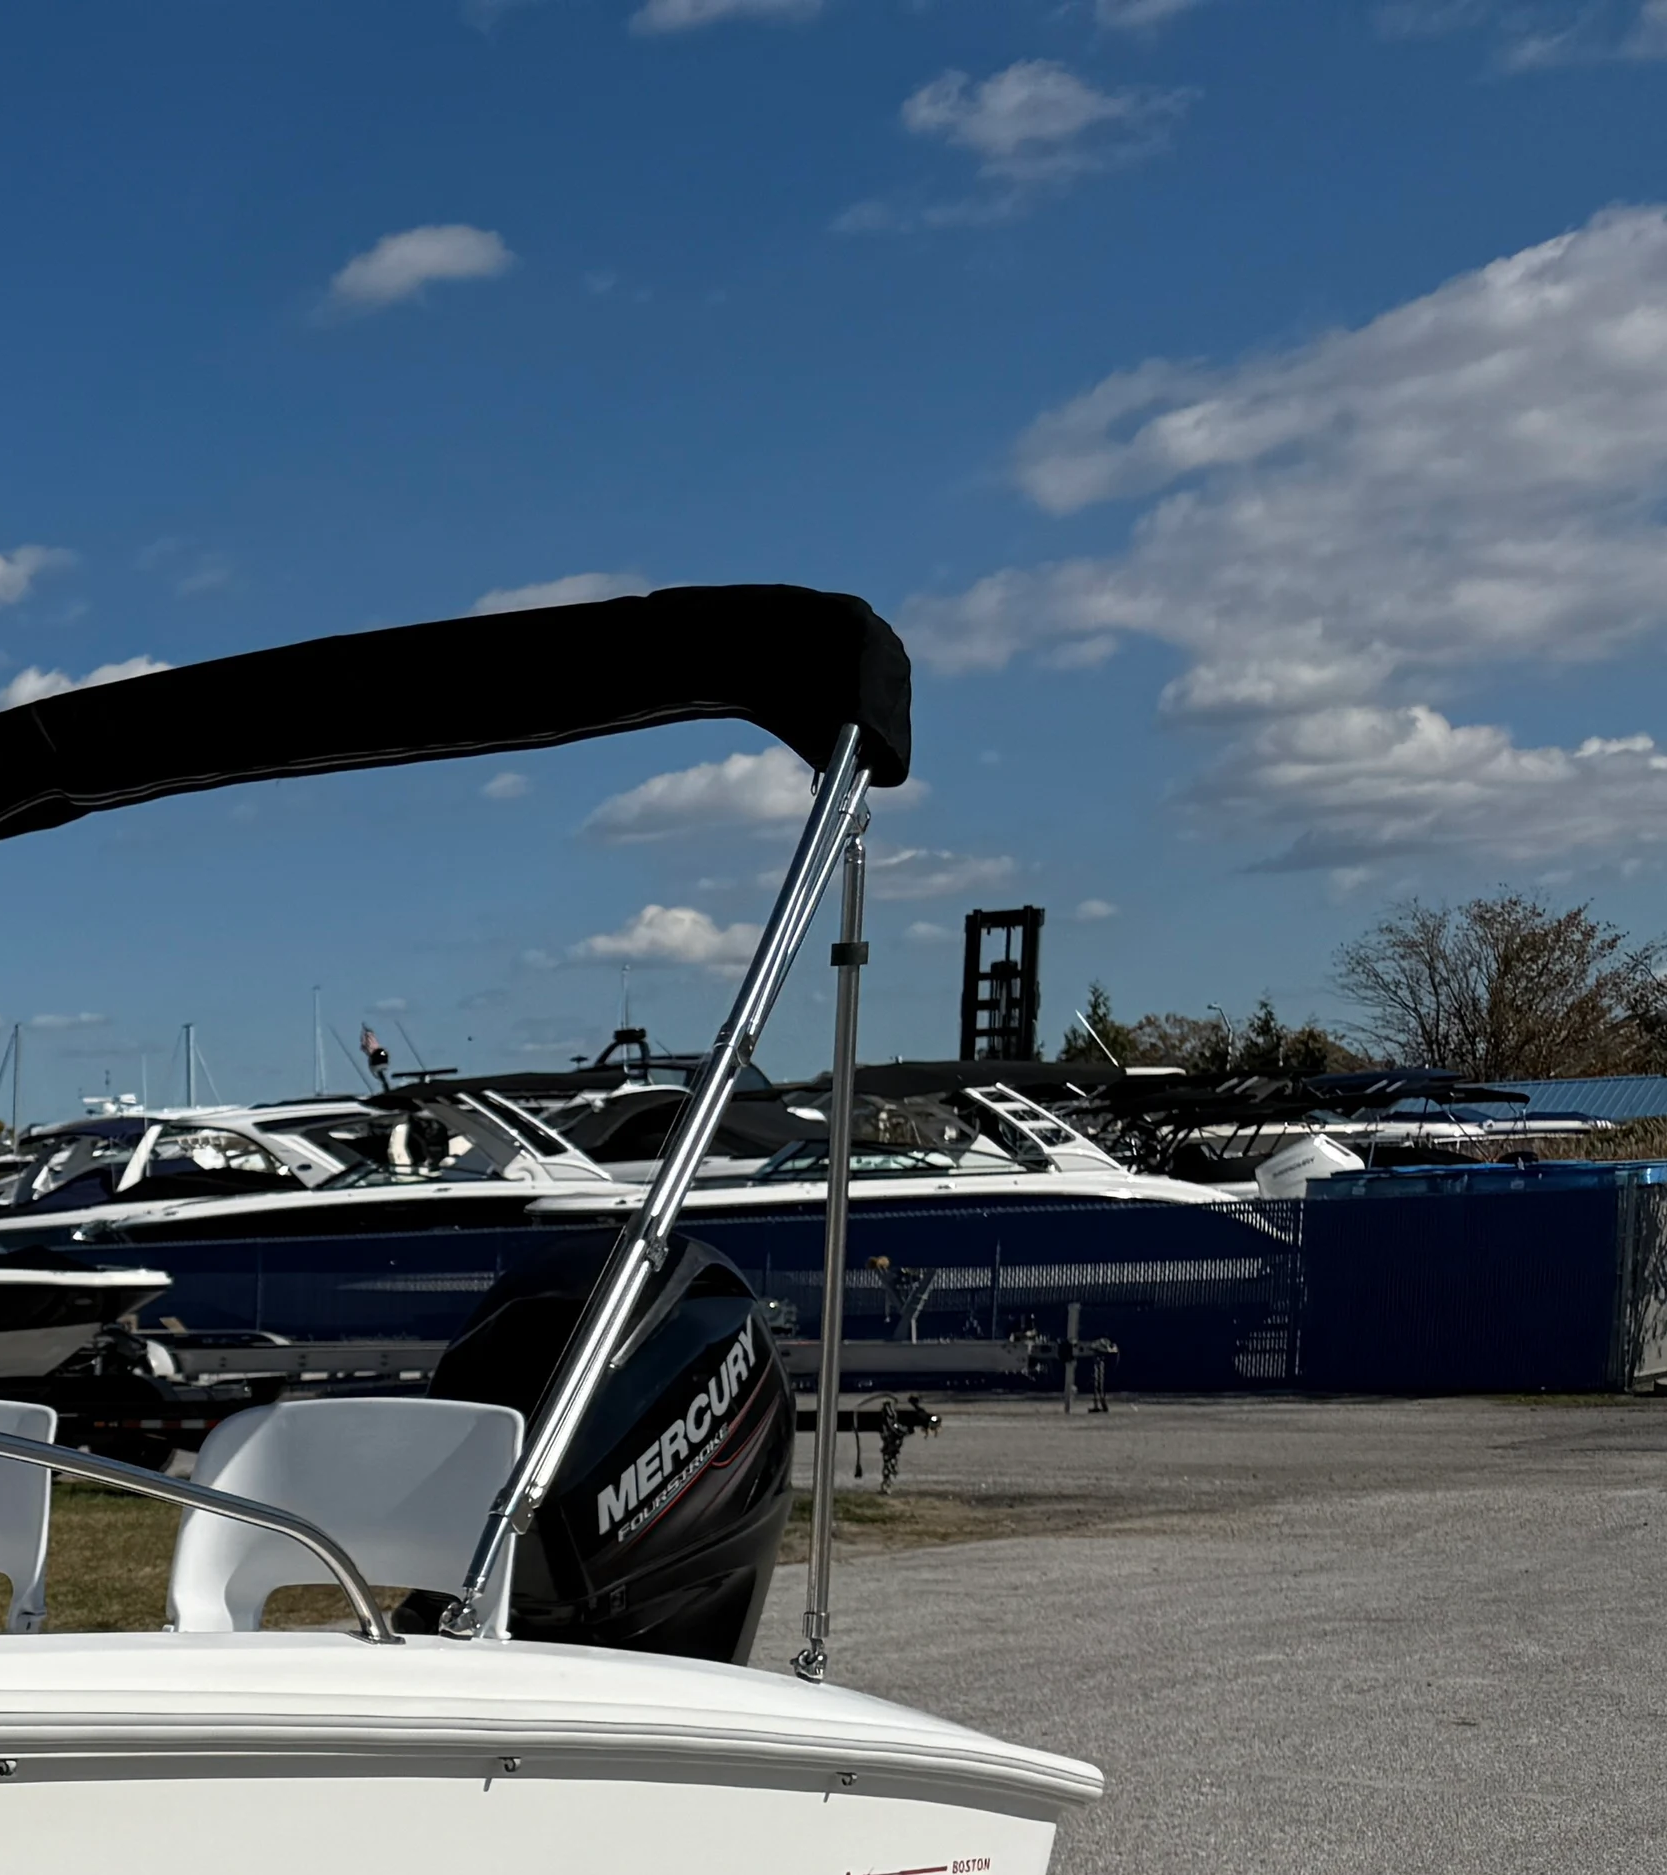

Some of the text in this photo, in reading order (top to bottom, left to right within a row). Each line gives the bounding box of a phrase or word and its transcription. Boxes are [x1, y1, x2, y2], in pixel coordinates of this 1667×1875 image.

[597, 1314, 757, 1535] MERCURY
[618, 1422, 729, 1542] FOURSTROKE
[952, 1858, 990, 1874] BOSTON
